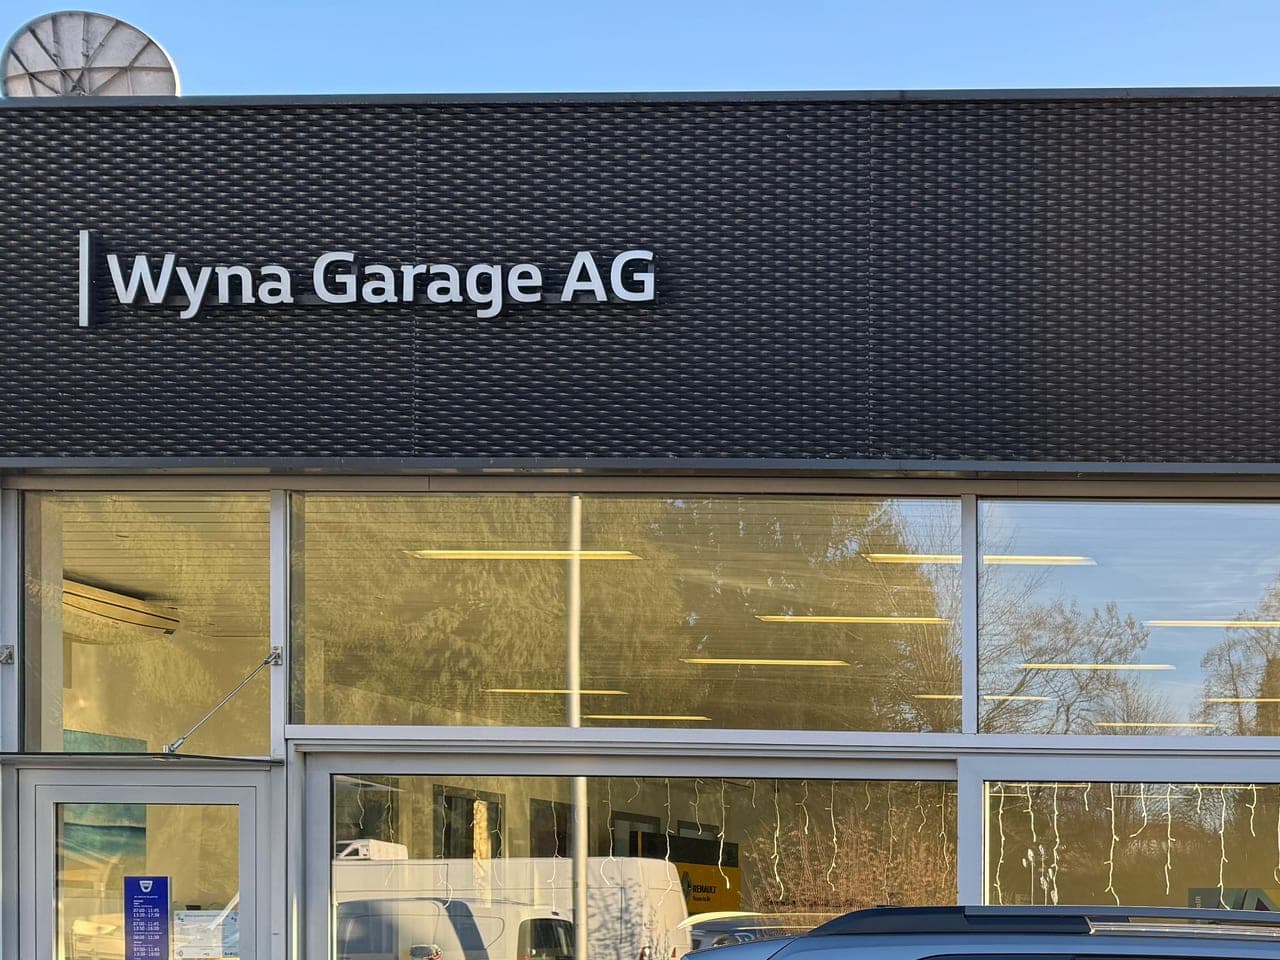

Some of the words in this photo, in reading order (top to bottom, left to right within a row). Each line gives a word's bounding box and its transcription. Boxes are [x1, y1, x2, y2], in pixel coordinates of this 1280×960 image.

[106, 254, 294, 319] Wyna
[313, 251, 543, 319] Garage
[560, 249, 655, 303] AG
